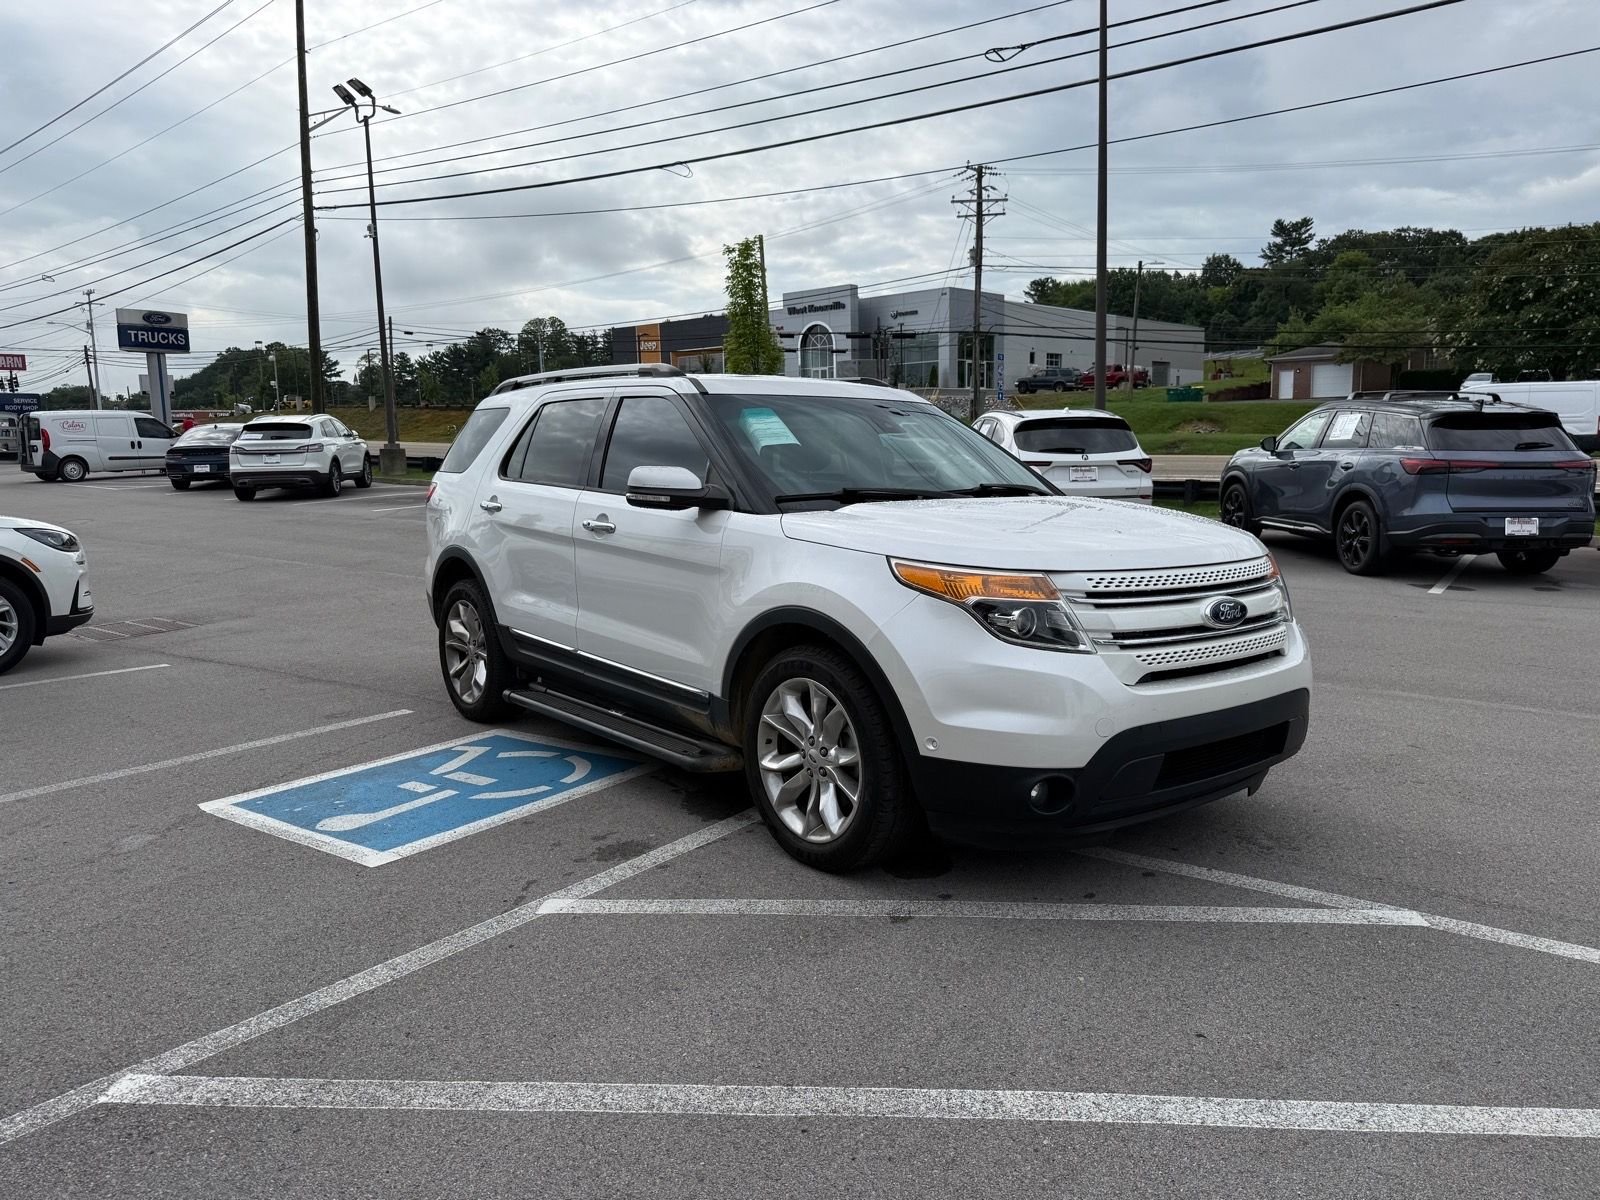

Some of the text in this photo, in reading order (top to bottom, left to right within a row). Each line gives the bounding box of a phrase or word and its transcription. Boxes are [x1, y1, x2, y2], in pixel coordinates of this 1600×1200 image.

[127, 330, 186, 345] TRUCKS
[0, 356, 23, 368] ARN
[1219, 602, 1242, 620] Ford
